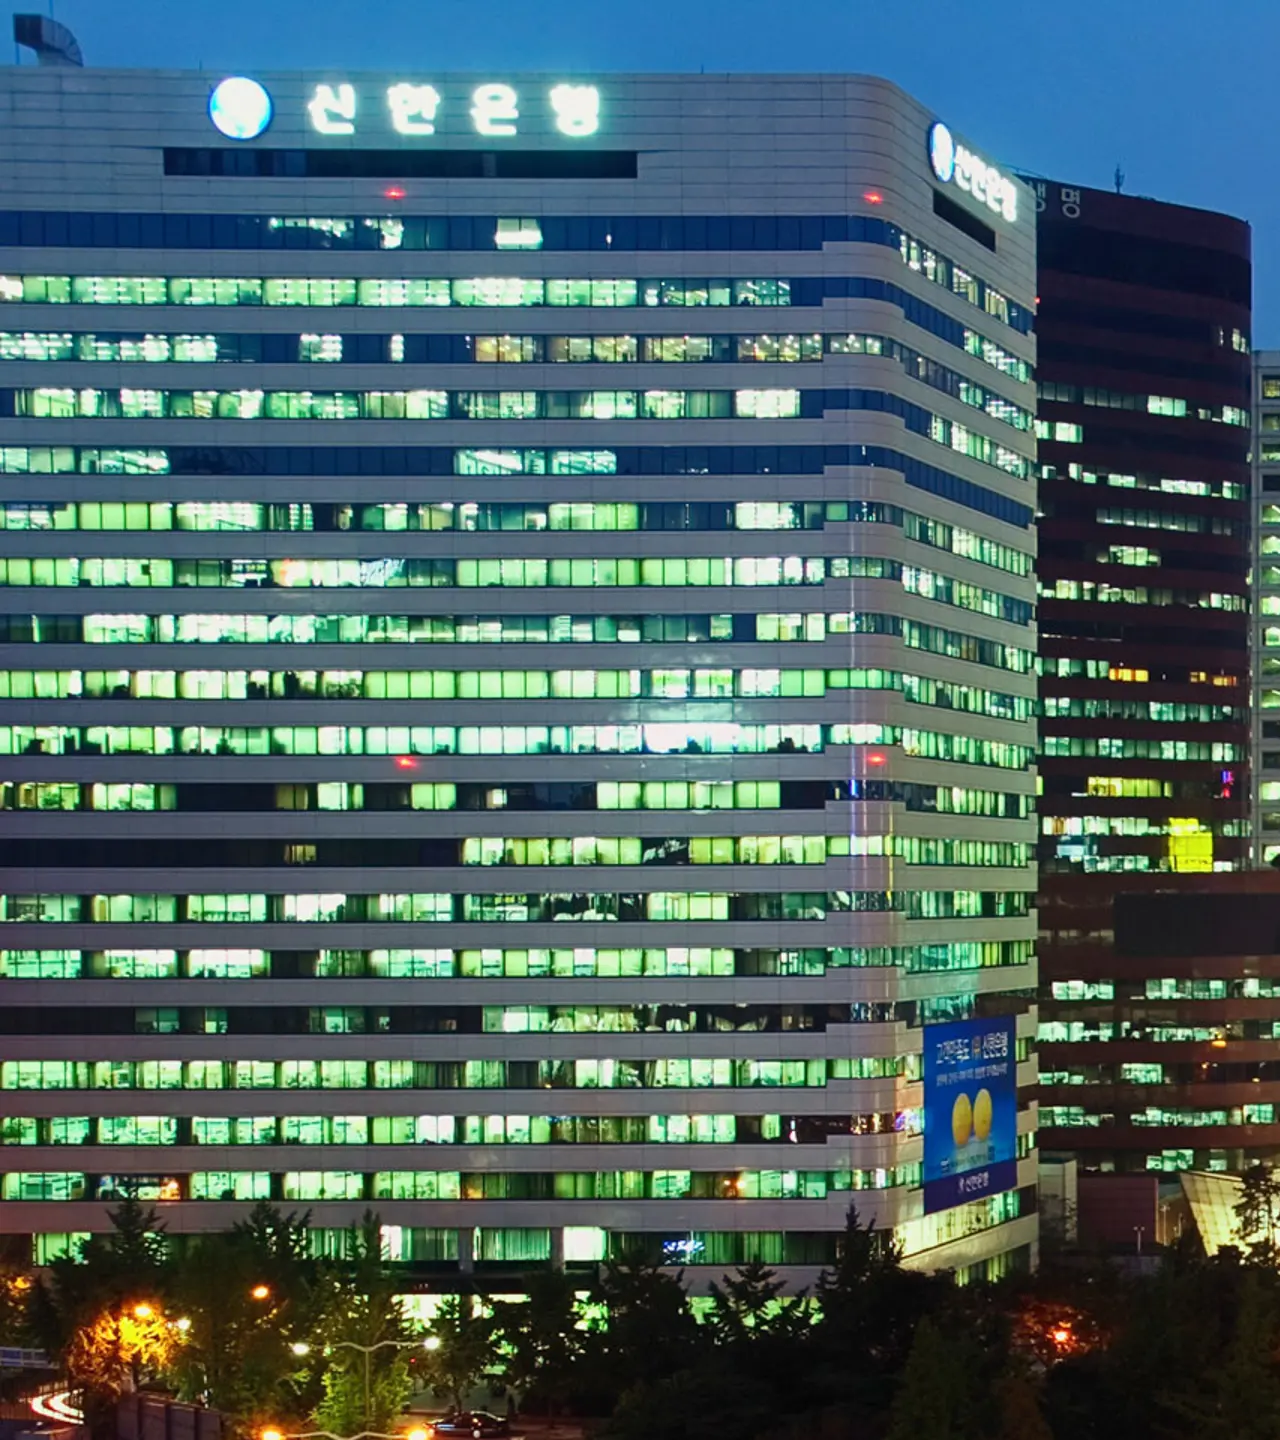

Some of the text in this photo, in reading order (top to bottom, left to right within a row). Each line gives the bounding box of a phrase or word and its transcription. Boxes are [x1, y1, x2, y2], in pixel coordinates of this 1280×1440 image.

[307, 81, 601, 138] 신한은행
[982, 1031, 1009, 1061] 신한은행
[964, 1171, 990, 1194] 신한은행
